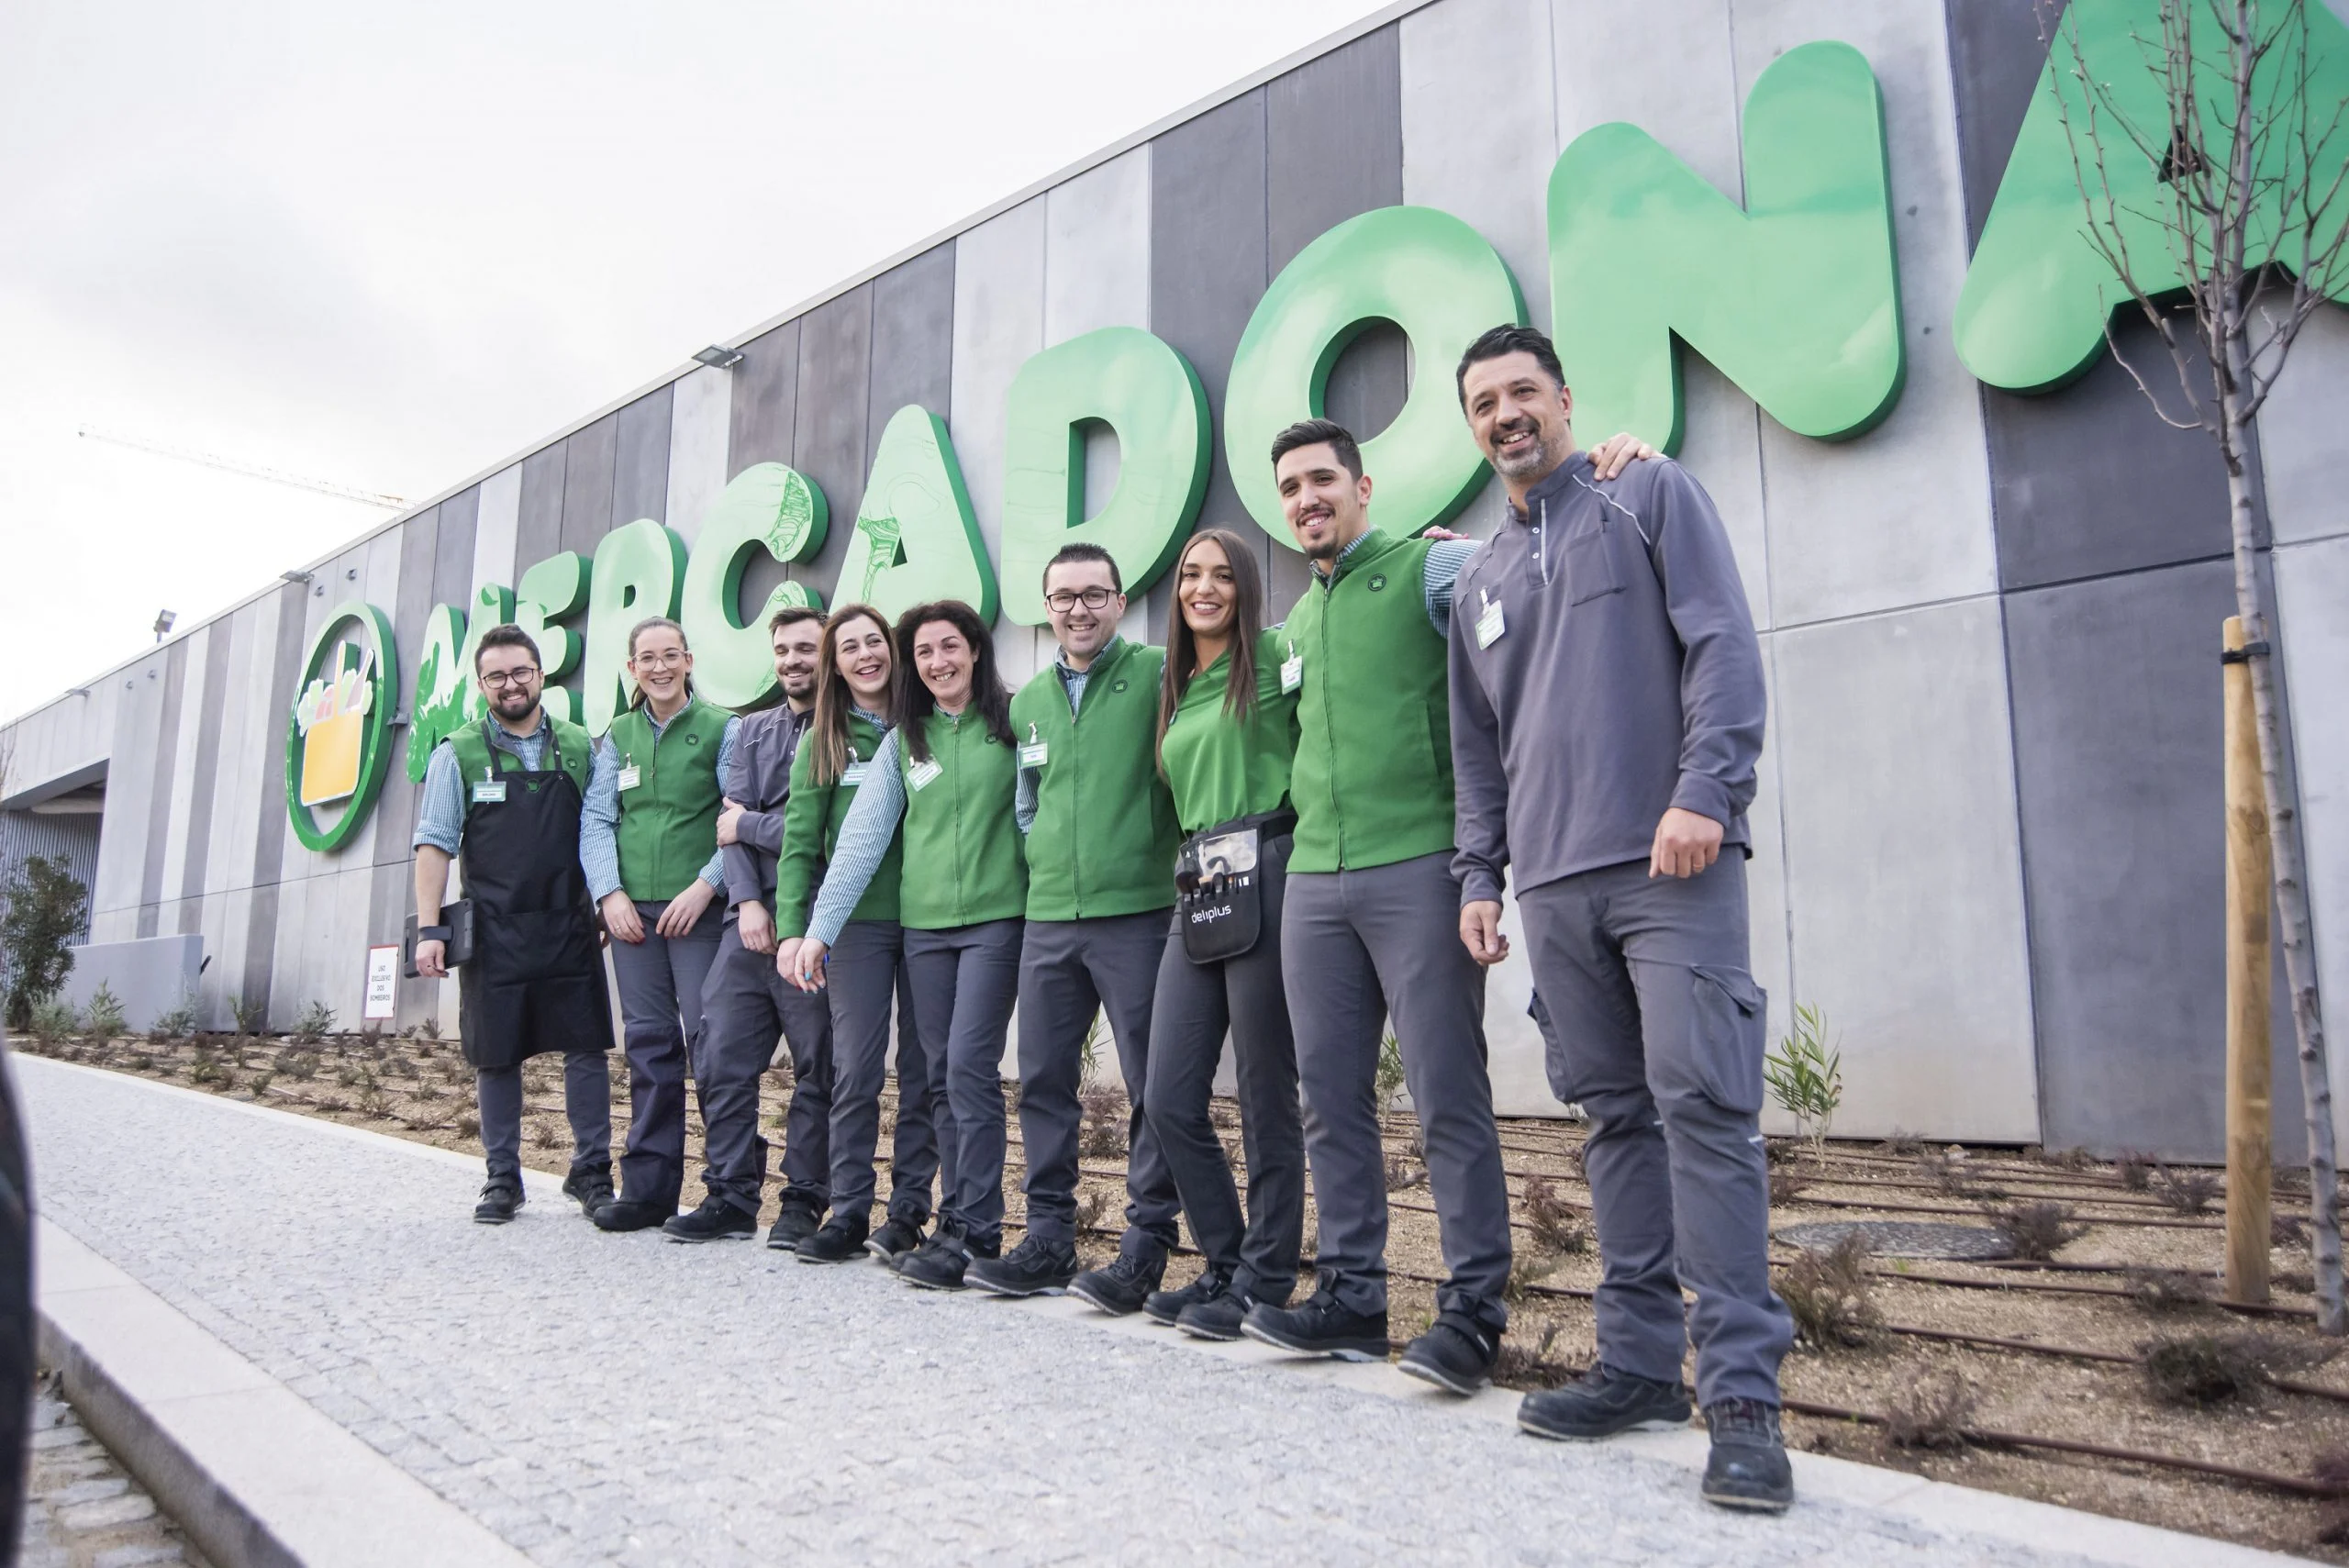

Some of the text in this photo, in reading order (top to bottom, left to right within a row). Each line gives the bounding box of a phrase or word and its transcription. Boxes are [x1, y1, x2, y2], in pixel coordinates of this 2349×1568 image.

[406, 0, 2349, 784] MERCADONA
[1191, 905, 1231, 923] deliplus
[370, 994, 391, 1002] BOMBEIROS
